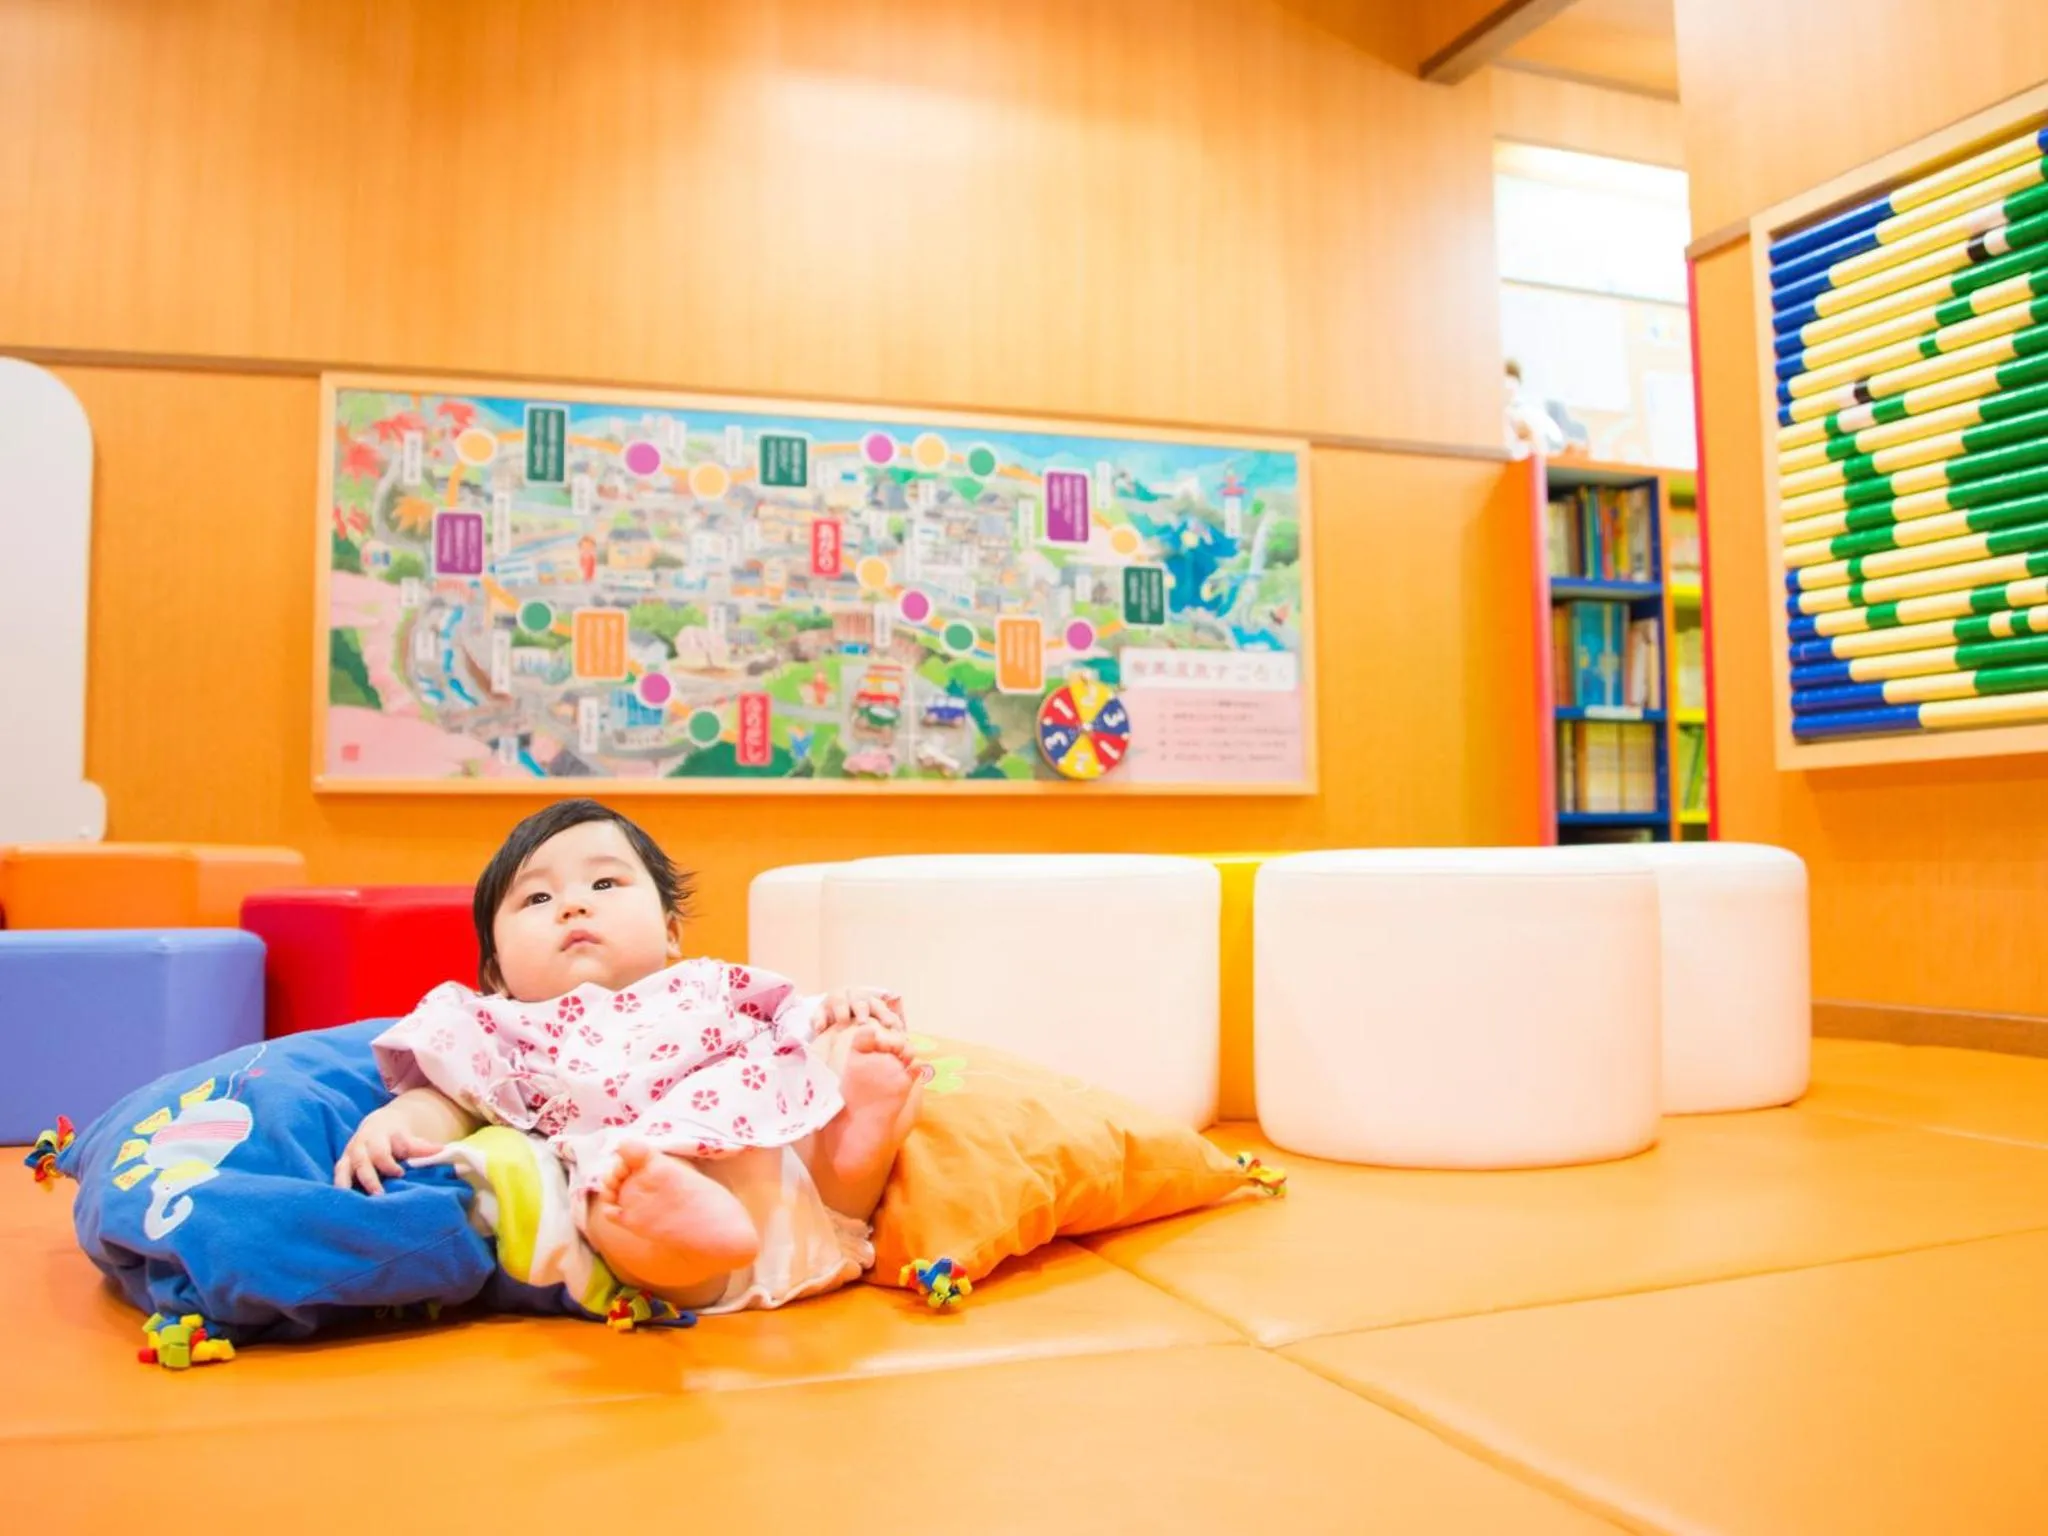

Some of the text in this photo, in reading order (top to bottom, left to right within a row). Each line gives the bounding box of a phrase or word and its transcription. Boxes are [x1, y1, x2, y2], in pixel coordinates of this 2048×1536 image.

[1053, 697, 1074, 719] 1
[1103, 708, 1125, 727] 3
[1044, 731, 1068, 751] 3
[1099, 739, 1121, 760] 1
